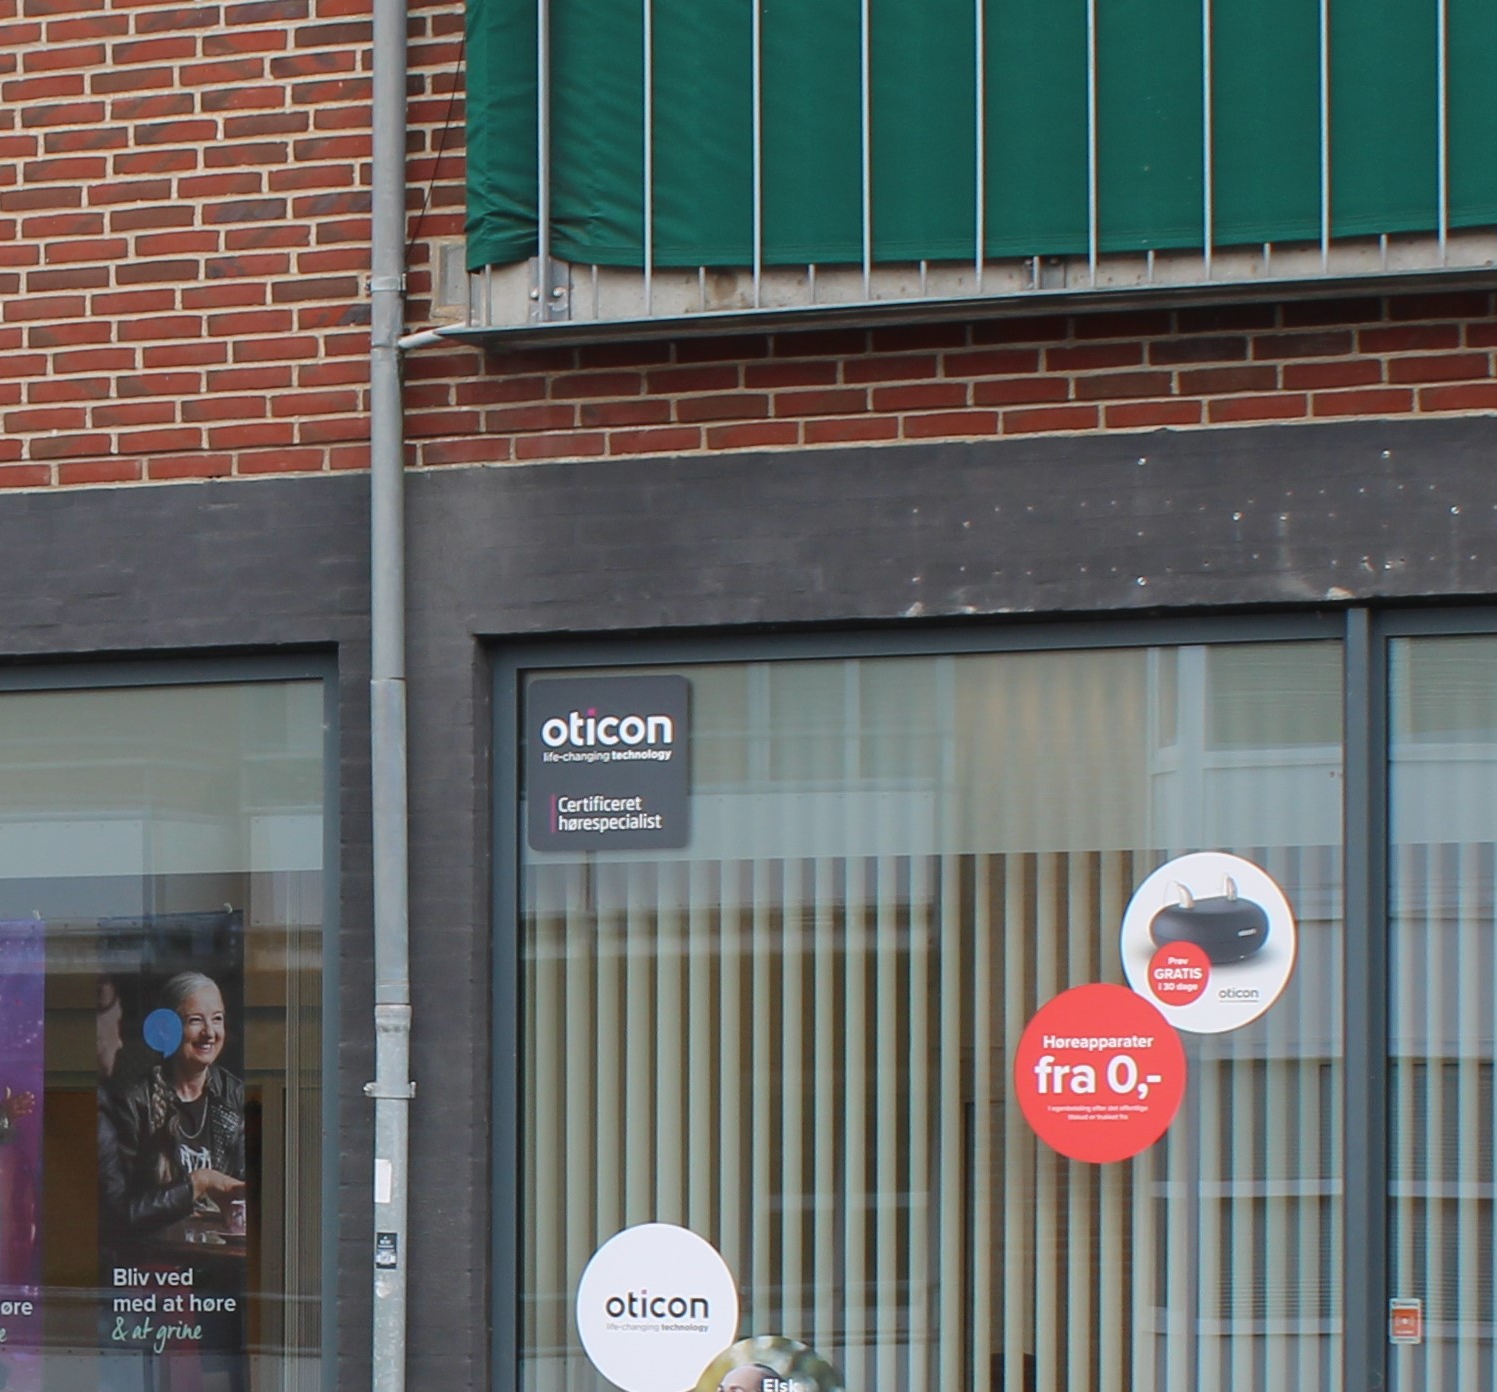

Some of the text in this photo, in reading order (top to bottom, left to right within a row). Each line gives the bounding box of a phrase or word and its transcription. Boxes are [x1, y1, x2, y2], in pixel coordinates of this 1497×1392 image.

[542, 708, 673, 747] oticon
[543, 749, 672, 763] life-changing technology
[558, 796, 642, 812] Certificeret
[558, 814, 663, 833] hørespecialist
[1154, 968, 1203, 980] GRATIS
[1176, 982, 1199, 992] dage
[1218, 988, 1259, 998] oticon
[1043, 1035, 1154, 1051] Høreapparater
[1034, 1054, 1162, 1100] fra 0,-
[113, 1268, 193, 1286] Bliv ved
[113, 1294, 236, 1312] med at høre
[606, 1289, 709, 1318] oticon
[112, 1316, 203, 1354] & at grine
[661, 1324, 709, 1332] technology
[763, 1379, 800, 1392] Elsk
